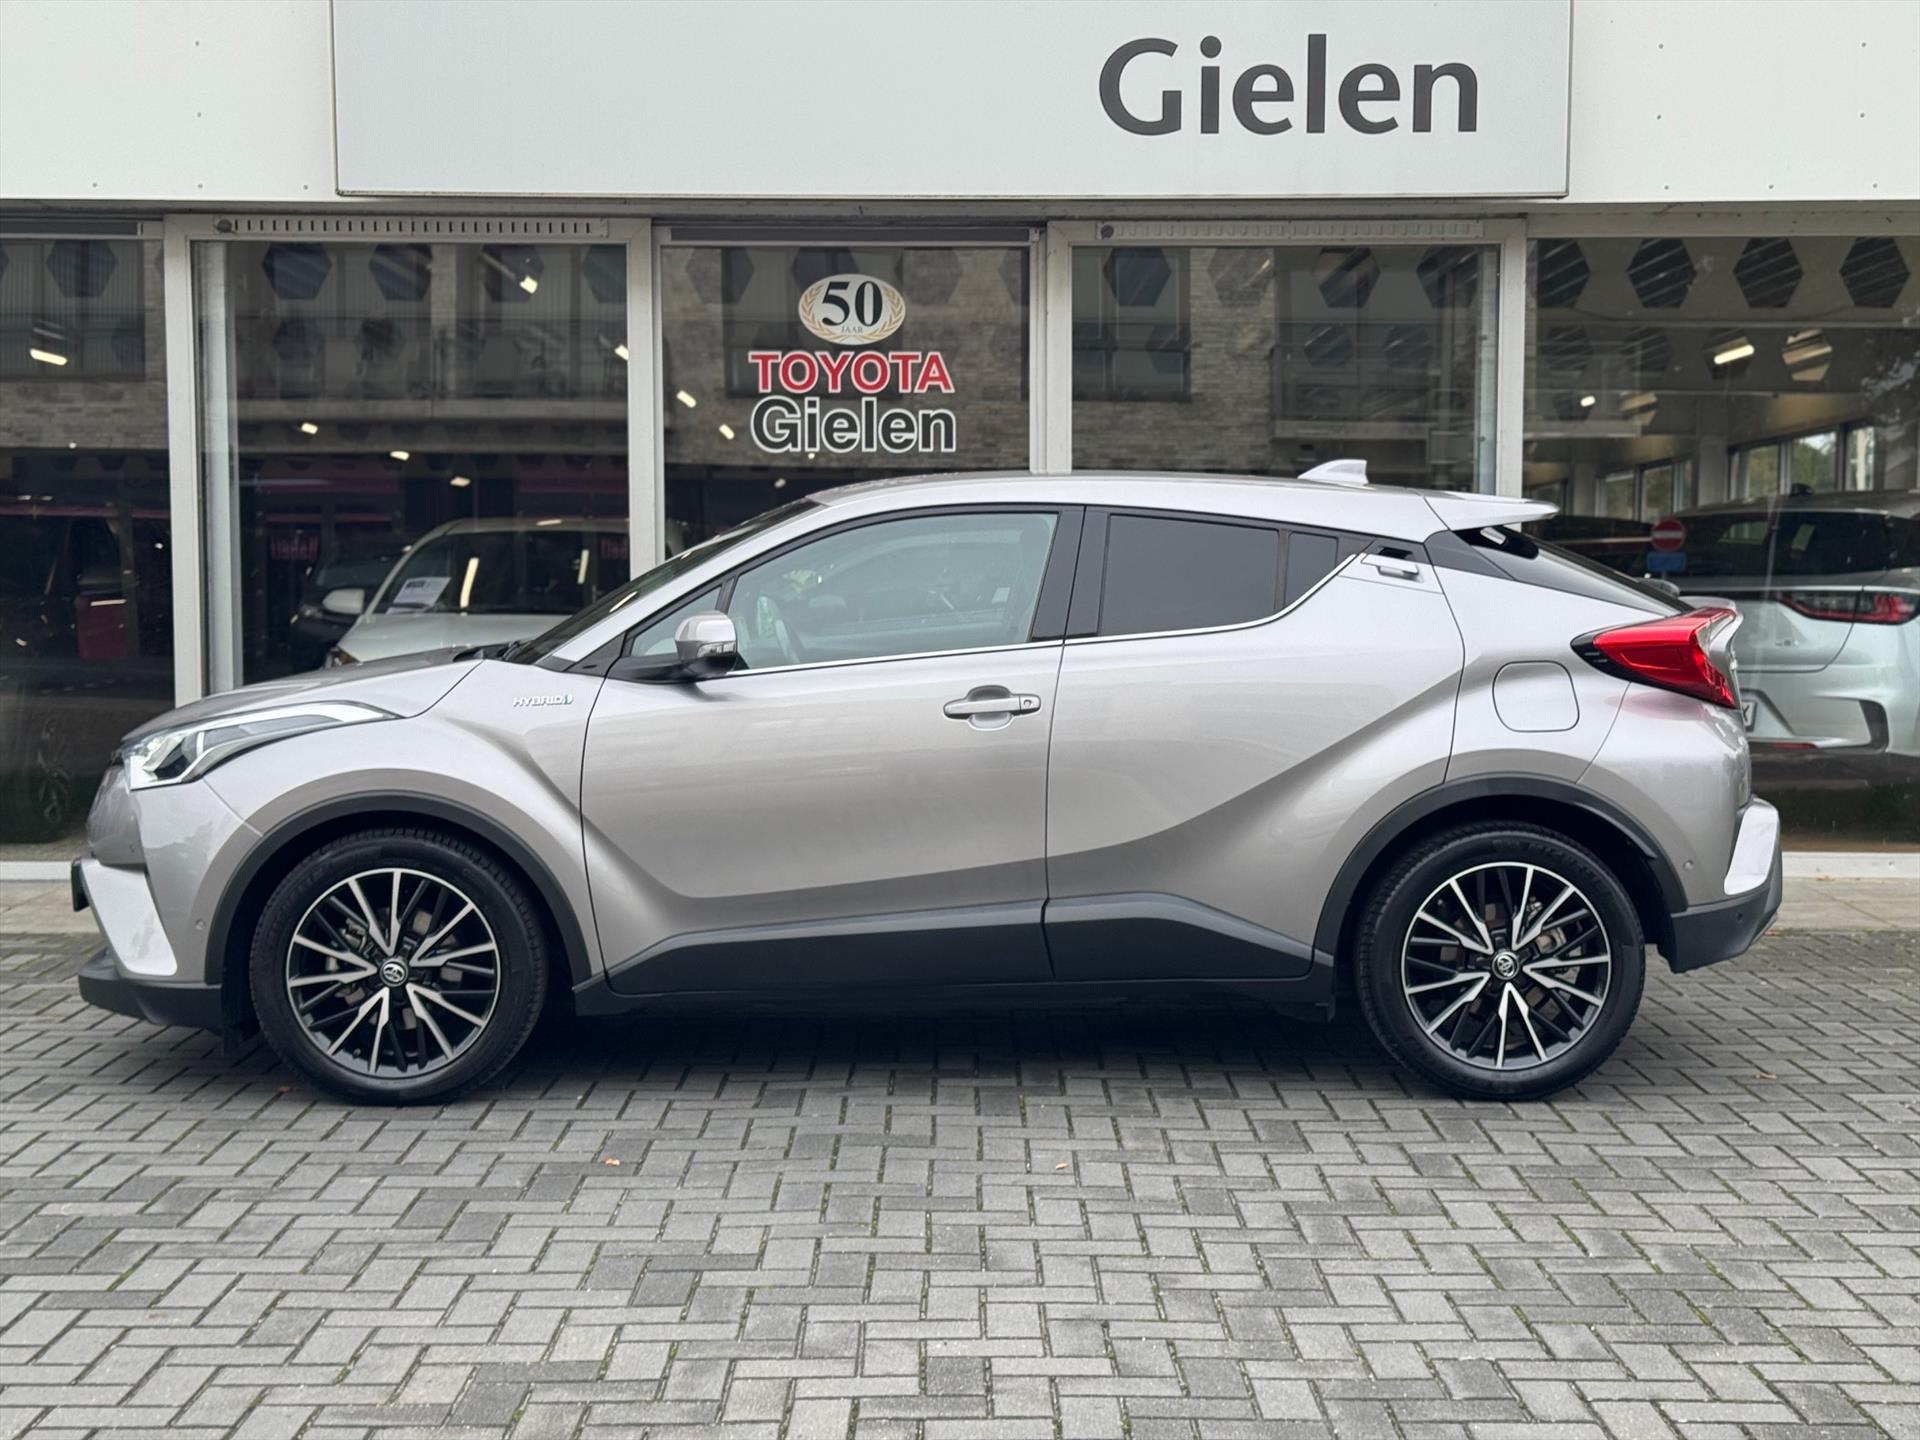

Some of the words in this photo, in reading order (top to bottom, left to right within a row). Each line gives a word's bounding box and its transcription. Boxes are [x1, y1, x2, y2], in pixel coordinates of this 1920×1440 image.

[1098, 33, 1479, 136] Gielen
[821, 280, 883, 327] 50
[841, 326, 864, 334] JAAR
[748, 350, 955, 394] TOYOTA
[750, 396, 957, 453] Gielen
[513, 695, 563, 707] HYBRID
